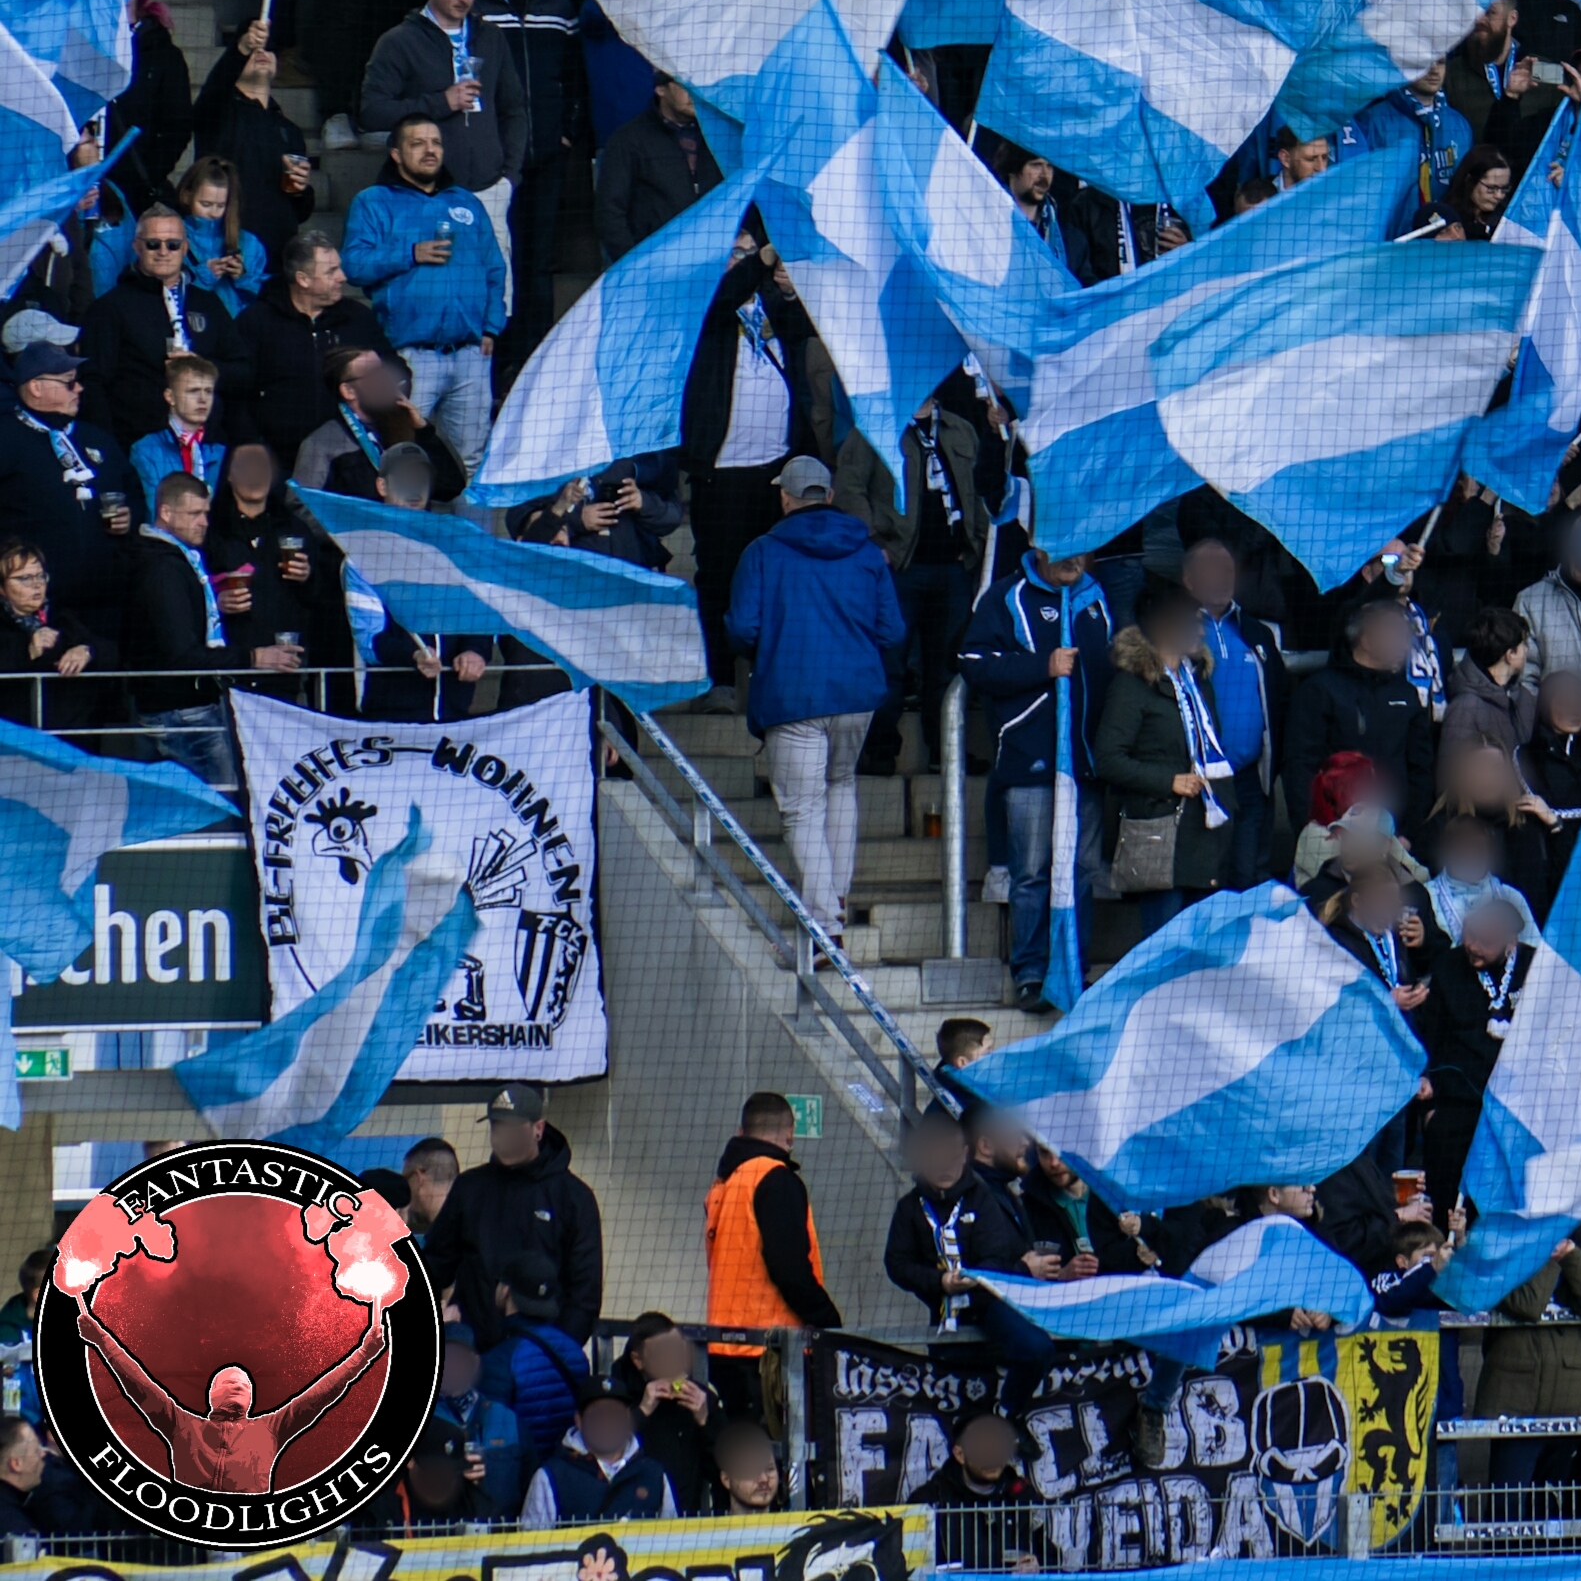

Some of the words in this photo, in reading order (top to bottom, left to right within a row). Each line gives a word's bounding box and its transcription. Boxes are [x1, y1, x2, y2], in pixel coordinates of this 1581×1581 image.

[431, 736, 582, 906] WOHNEN
[537, 914, 584, 947] FCK
[832, 1350, 961, 1411] lässig
